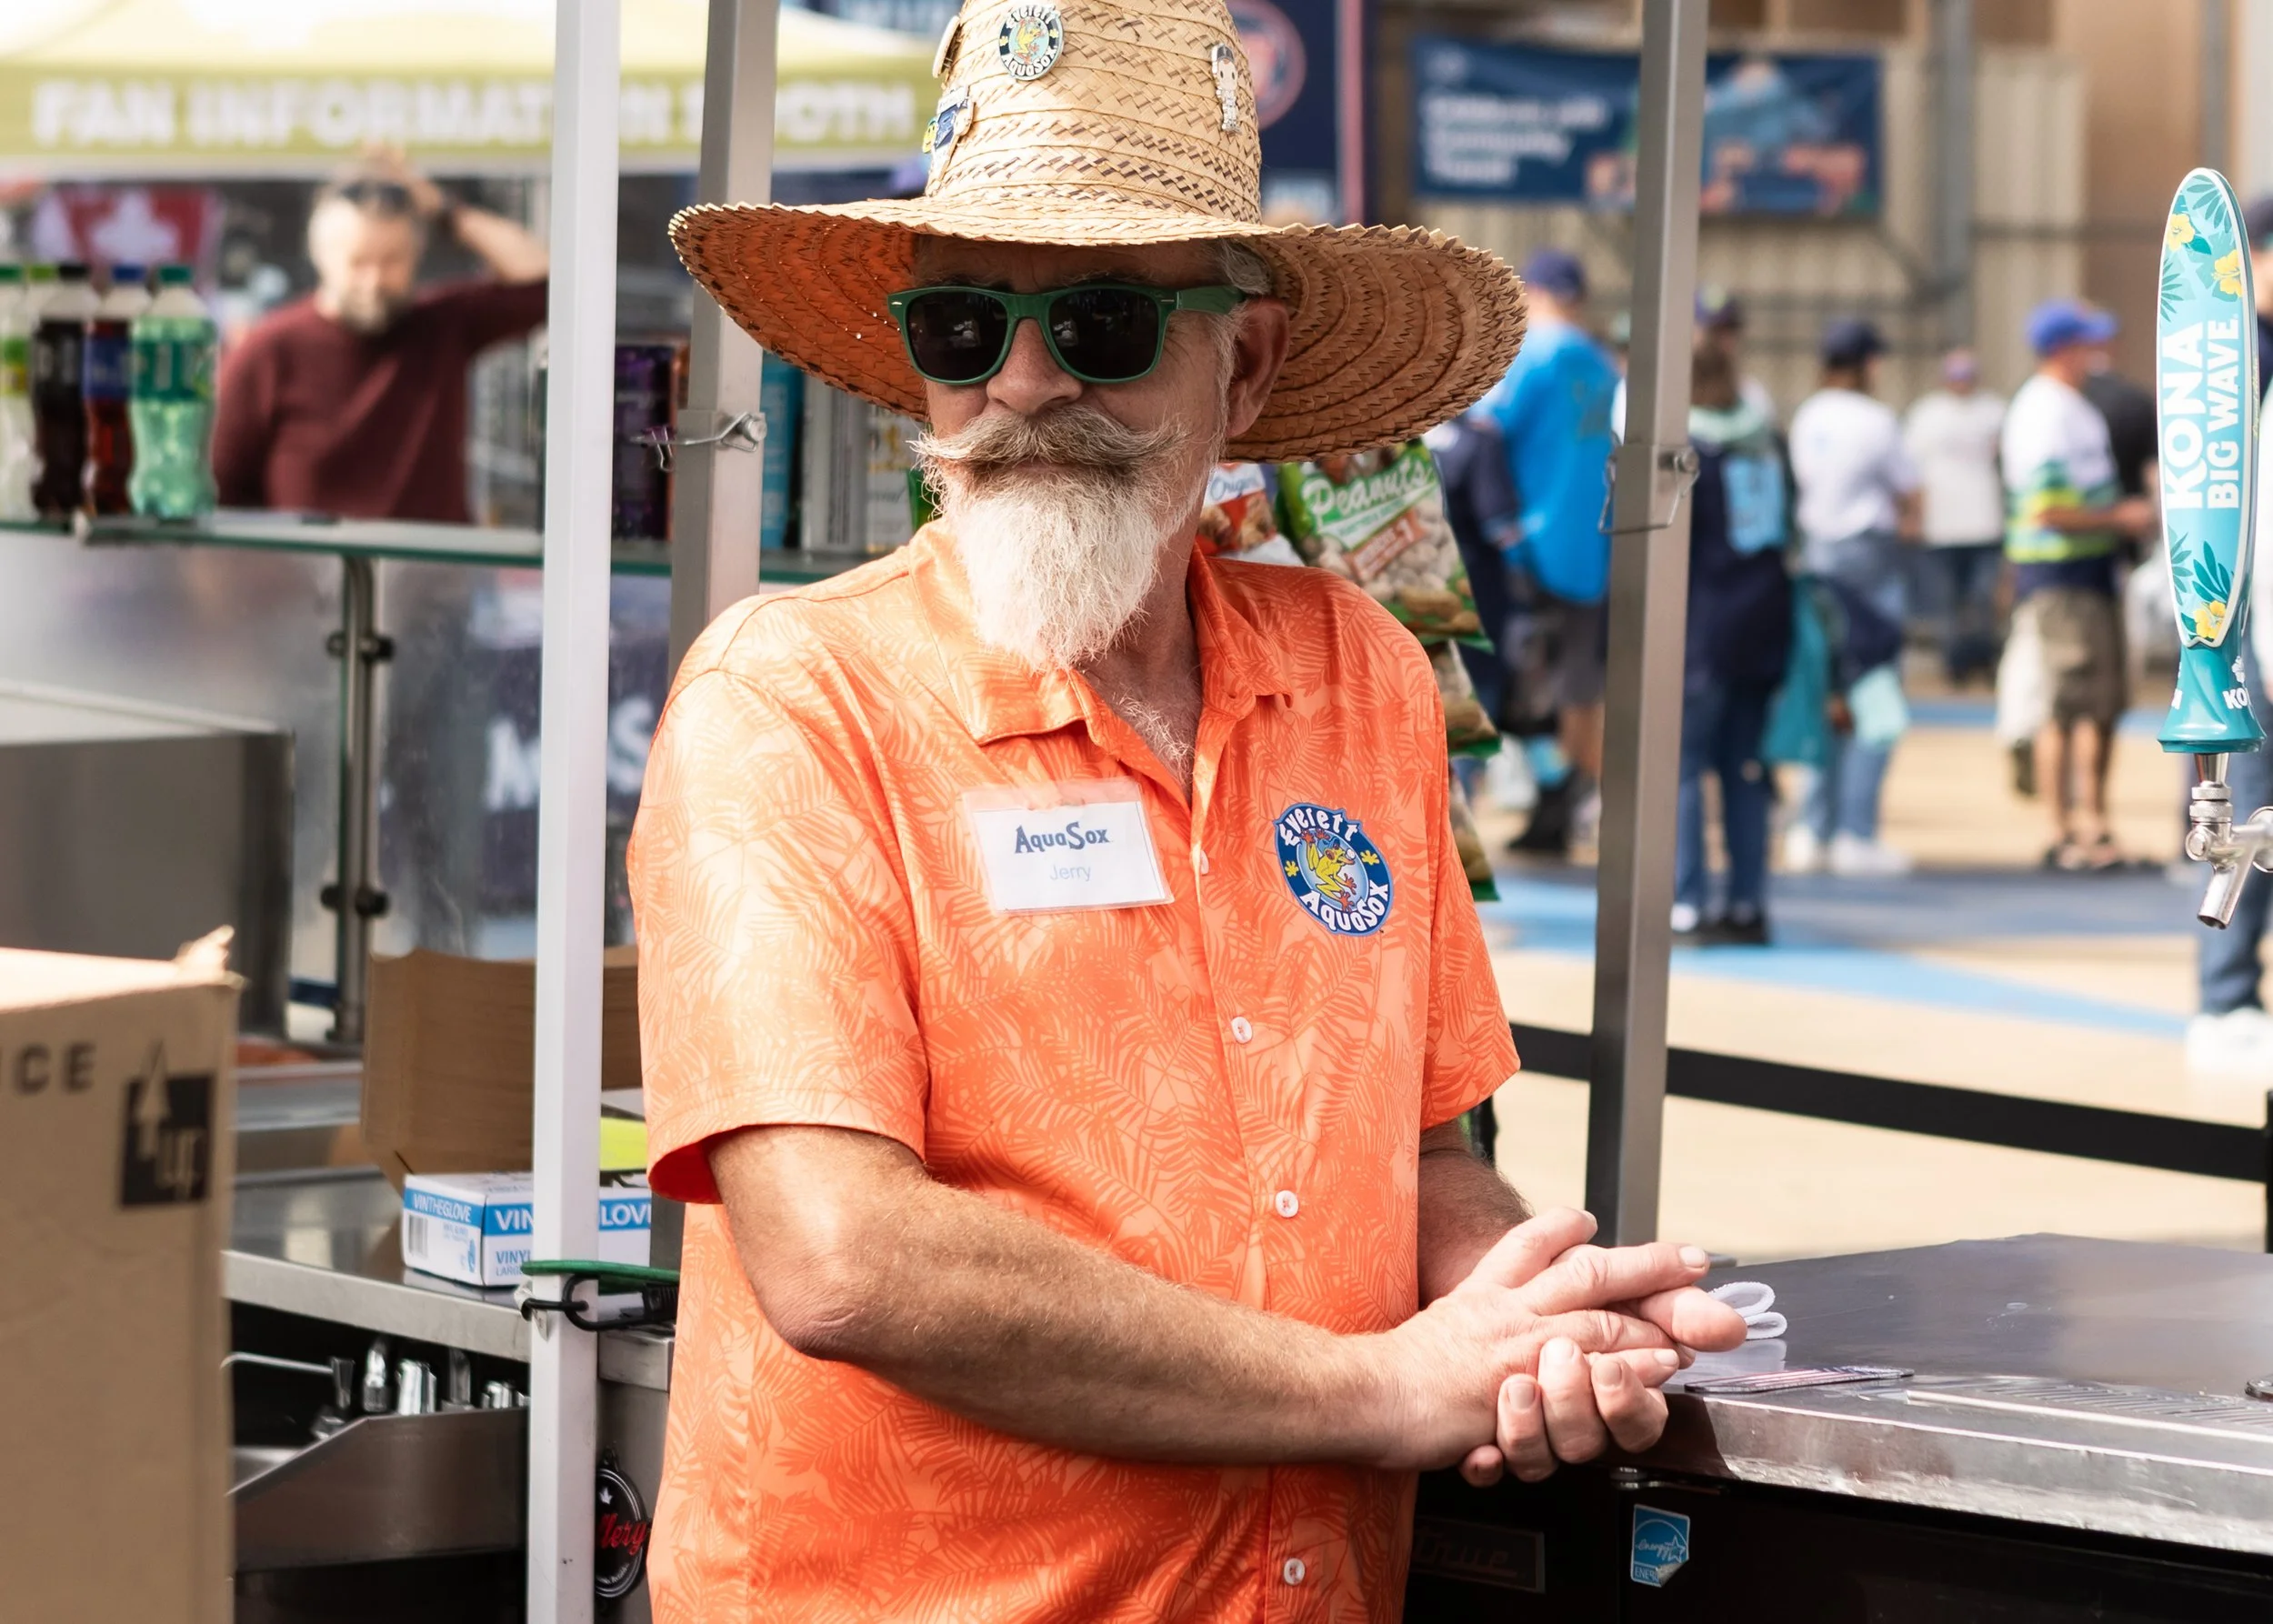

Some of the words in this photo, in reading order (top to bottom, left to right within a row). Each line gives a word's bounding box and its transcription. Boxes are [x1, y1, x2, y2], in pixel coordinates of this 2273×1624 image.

[33, 80, 177, 145] FAN
[188, 79, 671, 145] INFORMATN
[2207, 320, 2239, 433] WAVE
[2162, 321, 2208, 509] KONA
[1302, 457, 1433, 532] Peanuts
[2207, 441, 2239, 509] BIG
[1015, 821, 1110, 854] AquaSox
[1279, 807, 1358, 846] Everett
[1049, 865, 1092, 881] Jerry
[0, 1042, 96, 1096] CE
